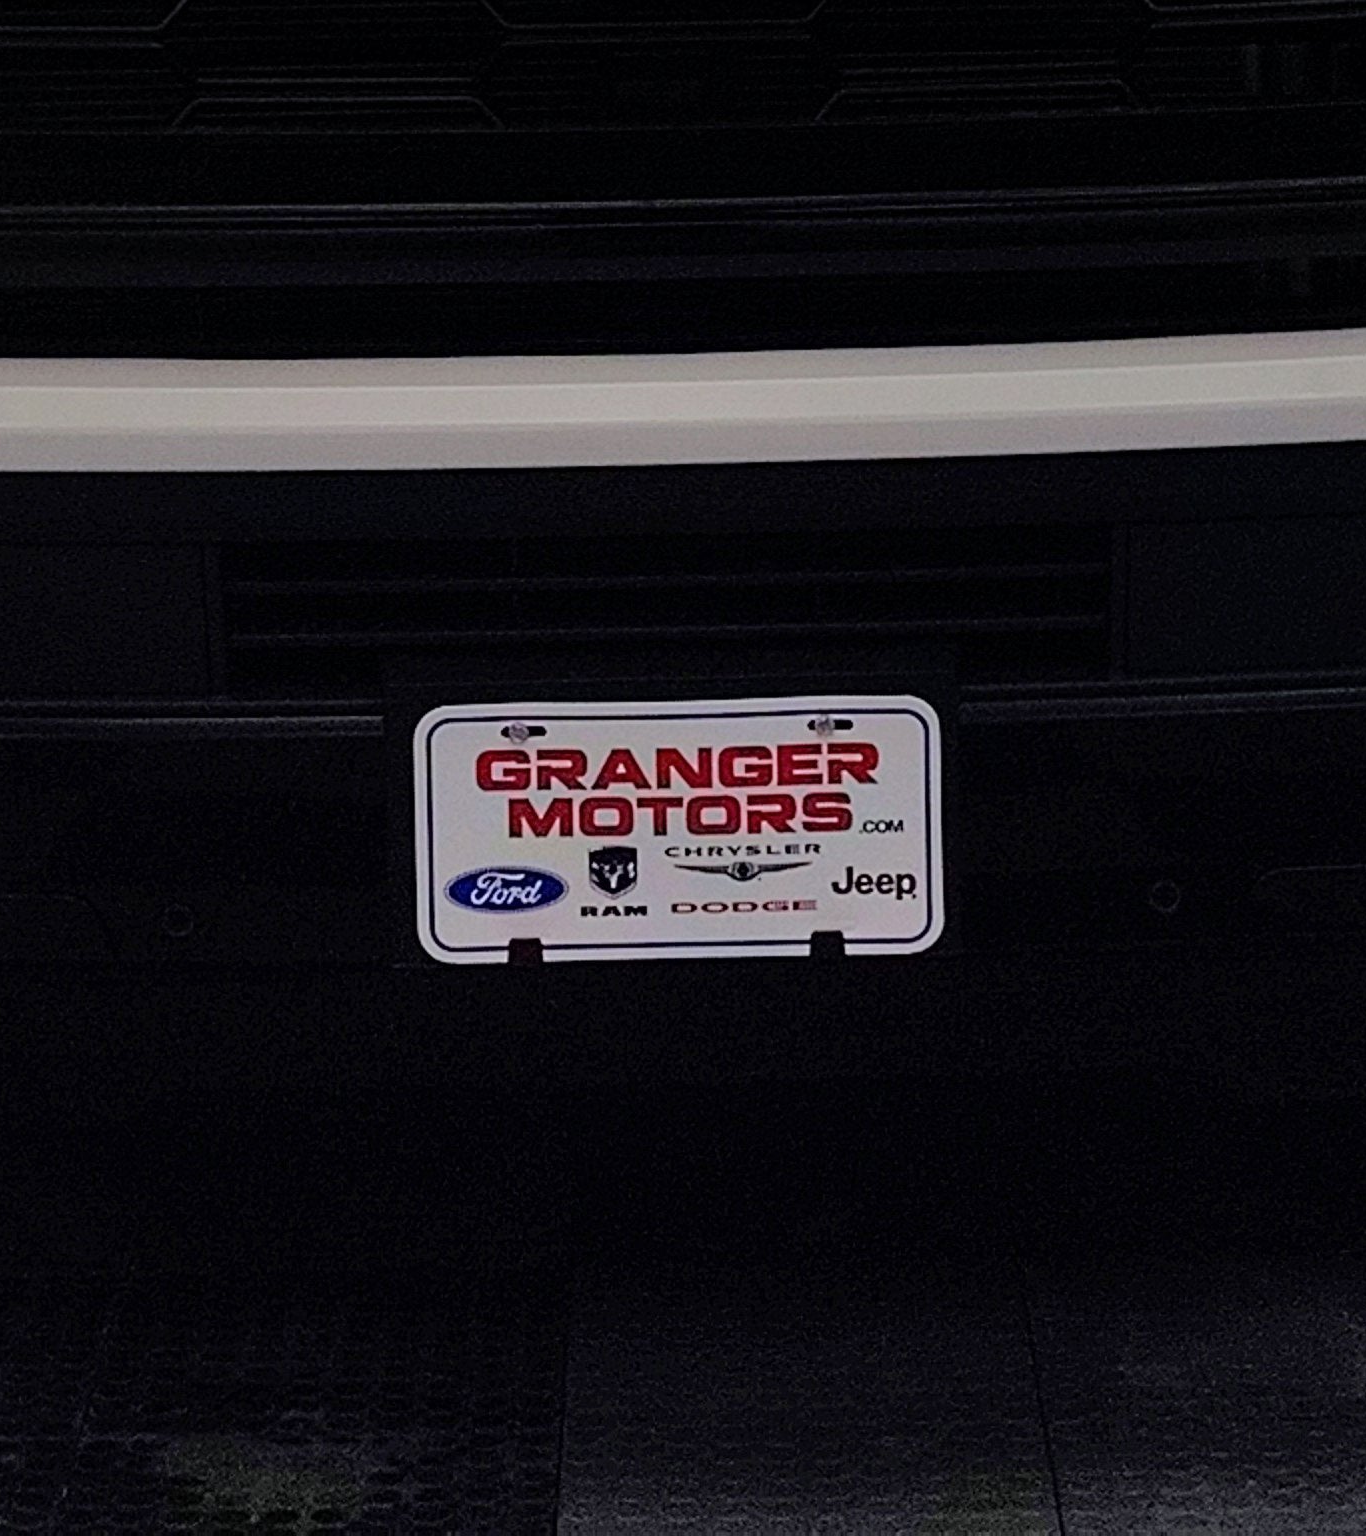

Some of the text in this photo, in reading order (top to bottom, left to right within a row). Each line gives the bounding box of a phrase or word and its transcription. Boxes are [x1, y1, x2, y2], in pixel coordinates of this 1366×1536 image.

[475, 742, 881, 792] GRANGER
[508, 791, 905, 839] MOTORS .COM
[664, 843, 822, 858] CHRYSLER
[469, 872, 542, 906] Ford
[830, 866, 918, 900] Jeep
[580, 904, 649, 918] RAM
[670, 900, 819, 915] DODGE
